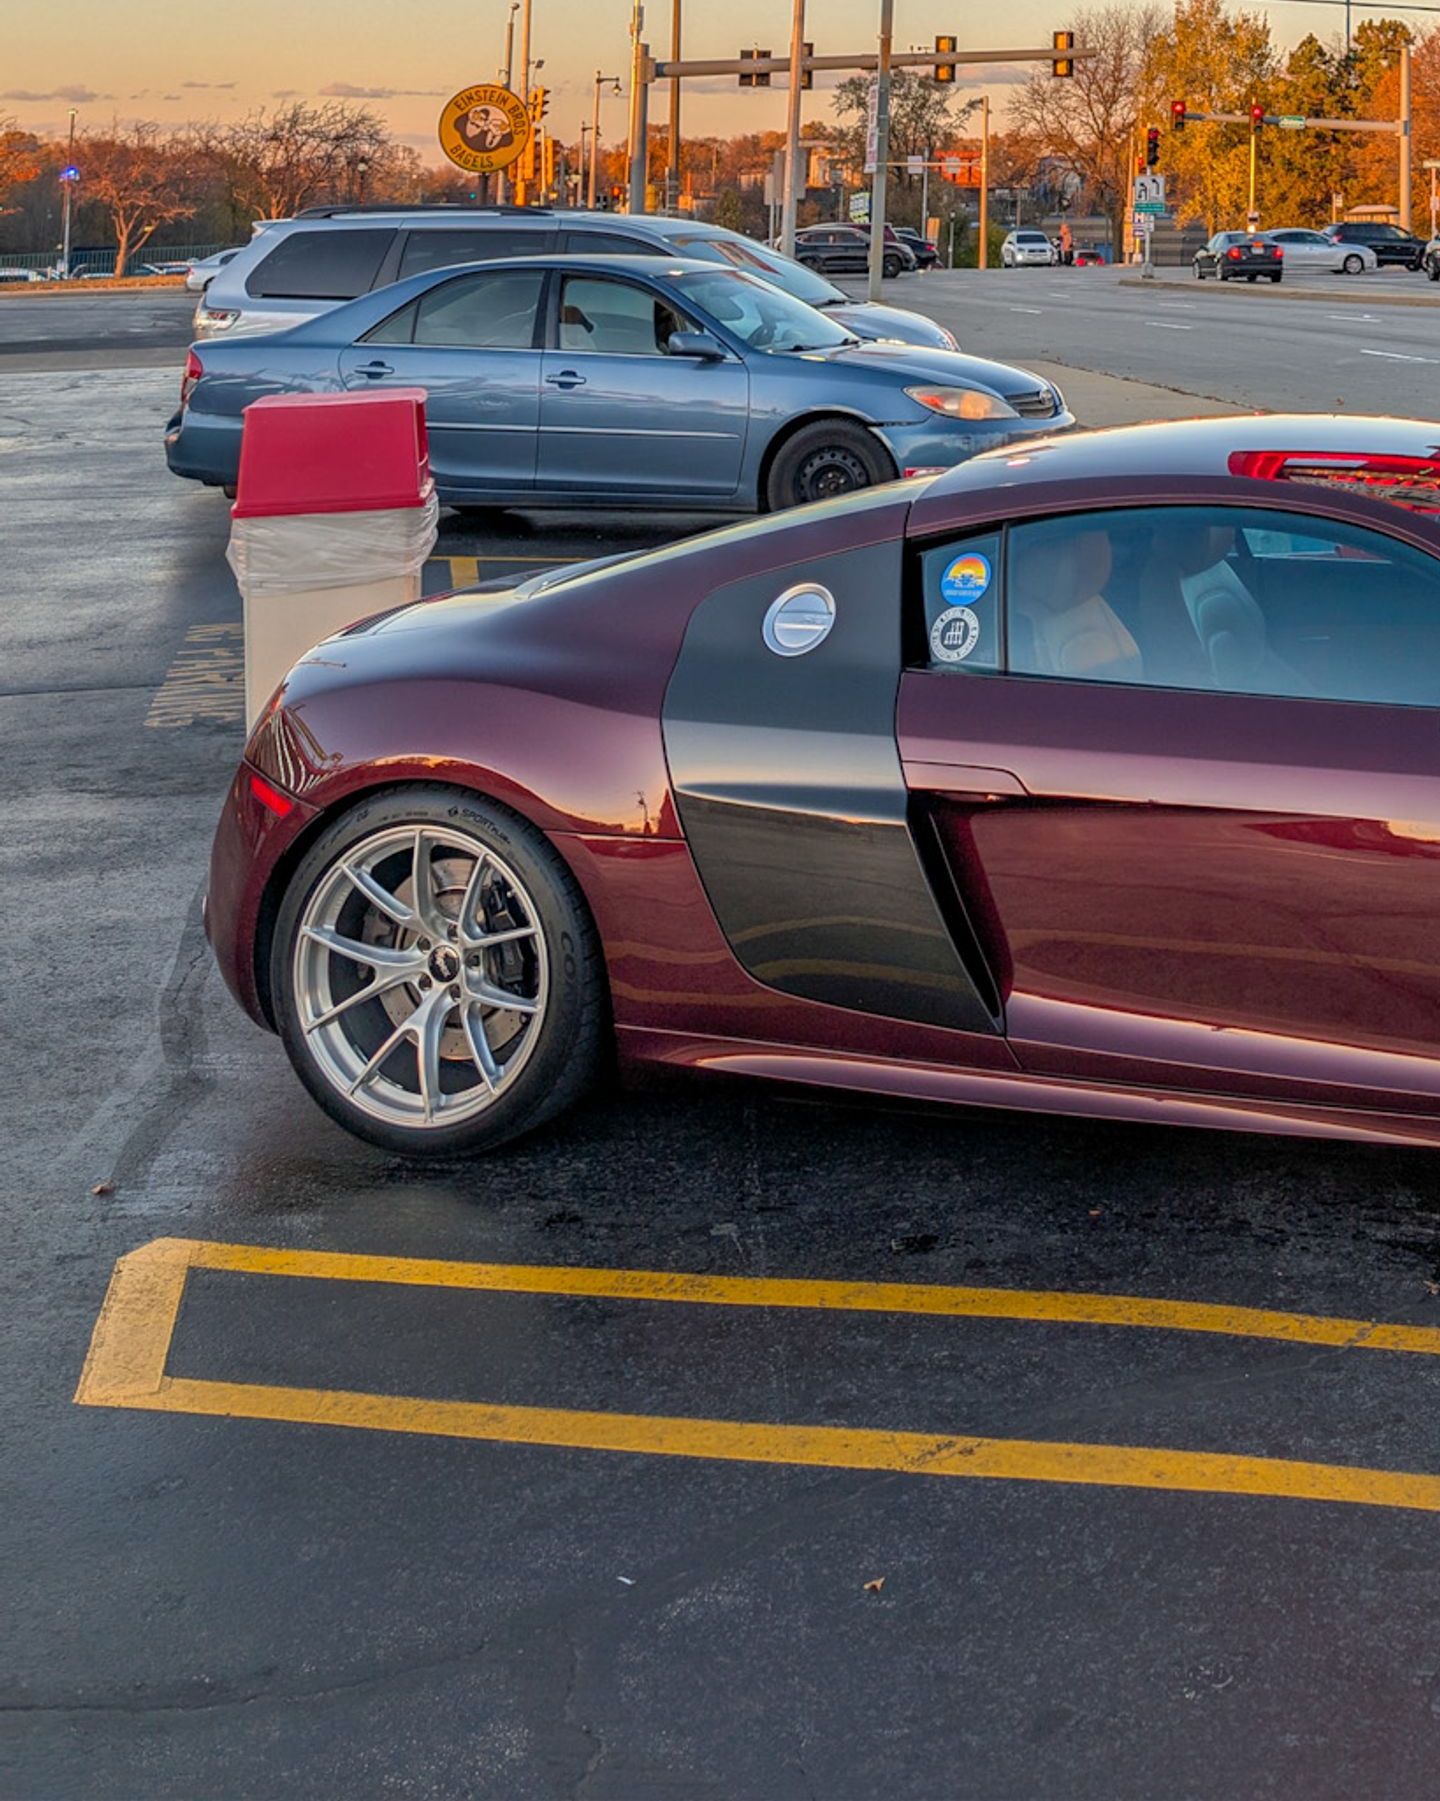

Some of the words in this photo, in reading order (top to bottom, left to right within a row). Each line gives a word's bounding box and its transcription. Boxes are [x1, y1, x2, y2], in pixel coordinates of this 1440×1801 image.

[453, 89, 510, 112] EINSTEIN
[508, 104, 526, 137] BROS
[449, 143, 494, 169] BAGELS
